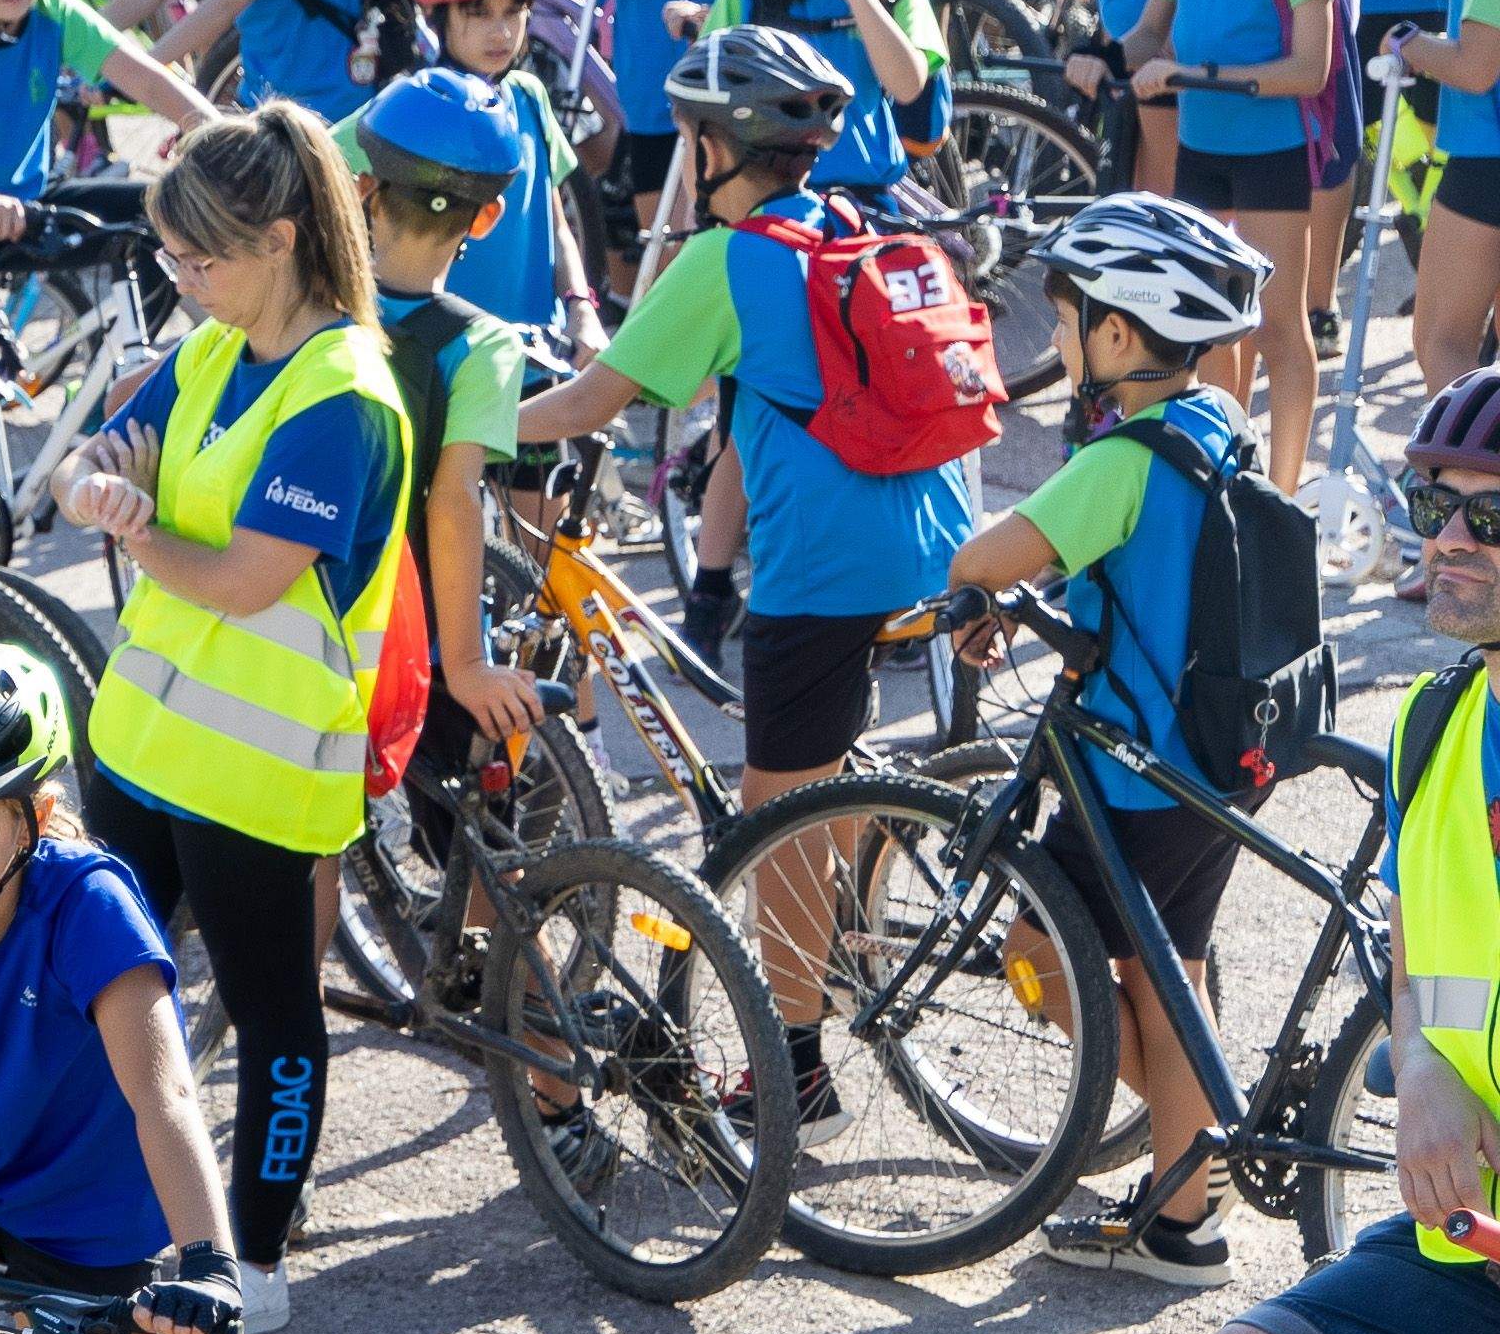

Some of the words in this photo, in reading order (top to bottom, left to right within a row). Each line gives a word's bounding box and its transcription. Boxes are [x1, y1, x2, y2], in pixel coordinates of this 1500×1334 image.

[884, 261, 950, 313] 93
[283, 490, 339, 521] FEDAC
[260, 1056, 313, 1183] FEDAC
